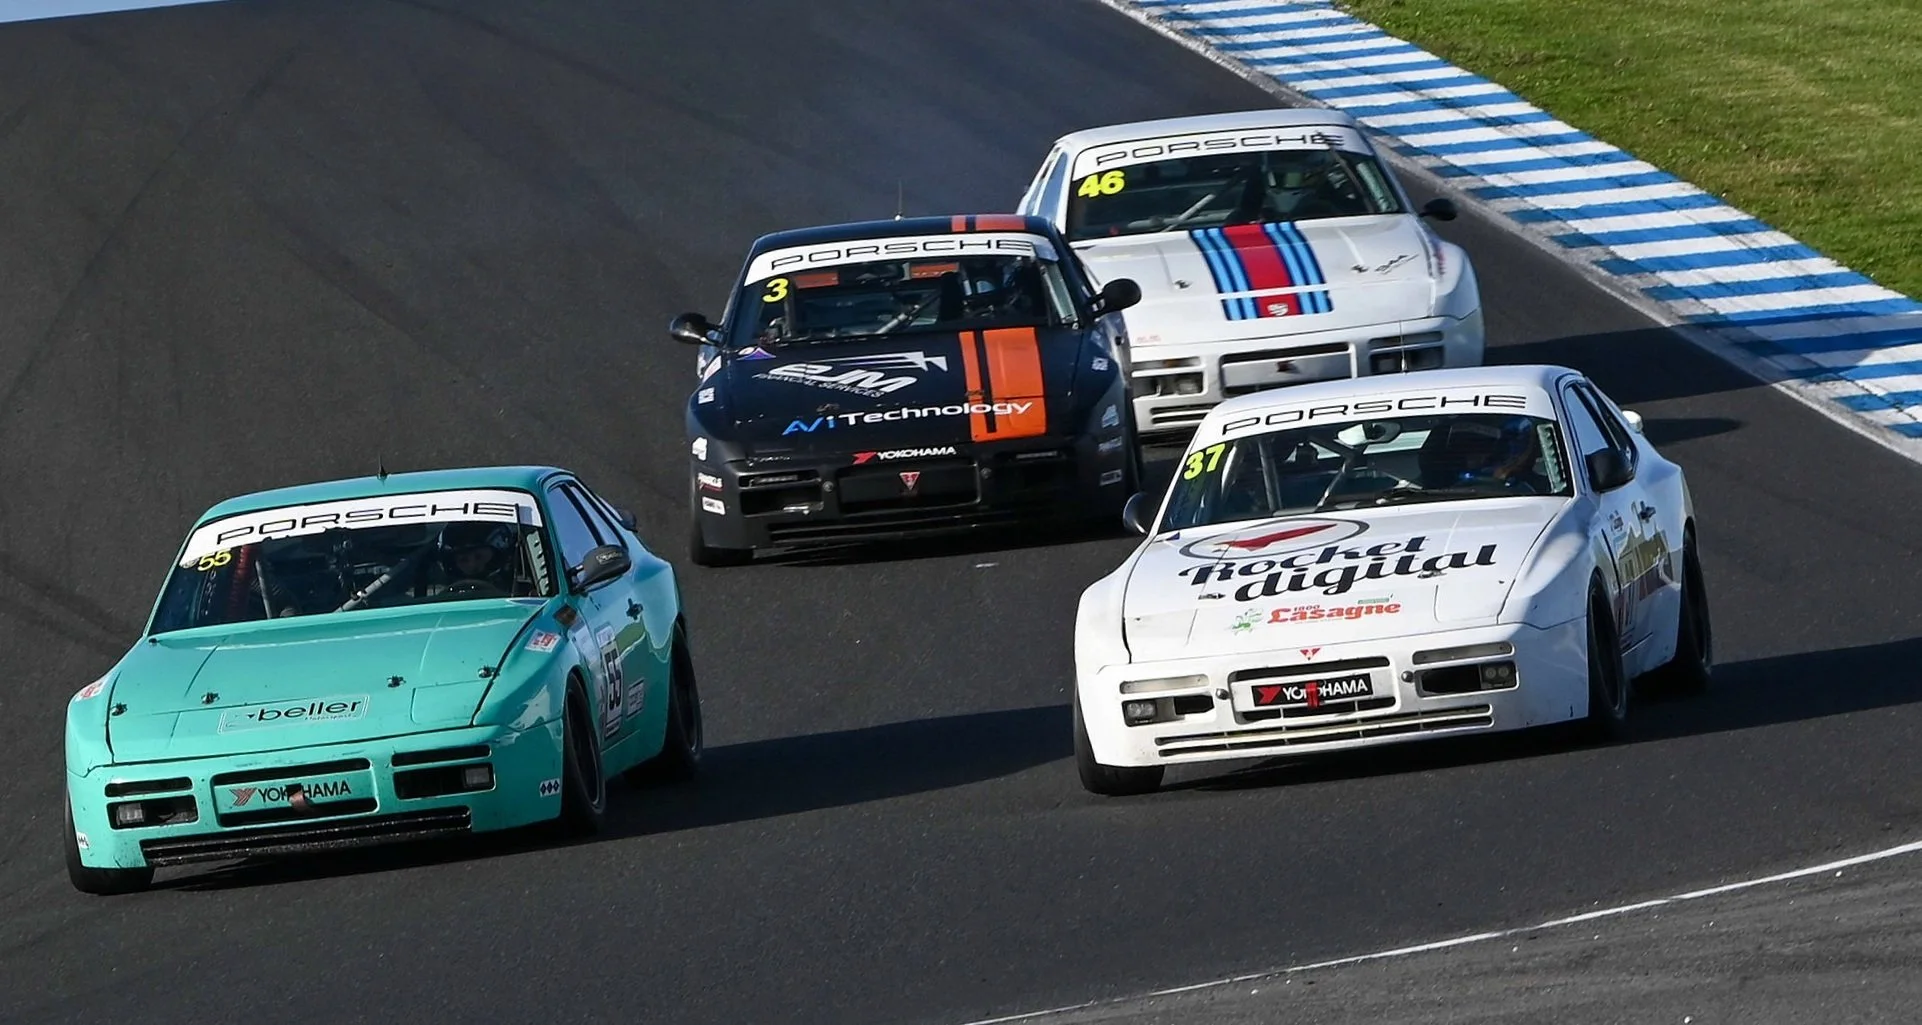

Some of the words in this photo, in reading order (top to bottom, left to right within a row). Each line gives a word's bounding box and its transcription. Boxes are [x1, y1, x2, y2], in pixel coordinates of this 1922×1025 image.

[1096, 134, 1344, 166] PORSCHE
[1077, 170, 1125, 198] 46
[771, 239, 1033, 270] PORSCHE
[762, 278, 789, 303] 3
[838, 401, 1033, 426] Technology
[1221, 395, 1527, 436] PORSCHE
[877, 446, 957, 460] YOKOHAMA
[1183, 443, 1227, 481] 37
[216, 502, 516, 545] PORSCHE
[197, 550, 232, 571] 55
[1178, 536, 1430, 586] Rocket
[1234, 543, 1498, 602] digital
[1267, 603, 1401, 624] Lasagne
[1282, 679, 1368, 700] YOHAMA
[257, 702, 362, 722] beller
[258, 780, 352, 803] YOKHAMA
